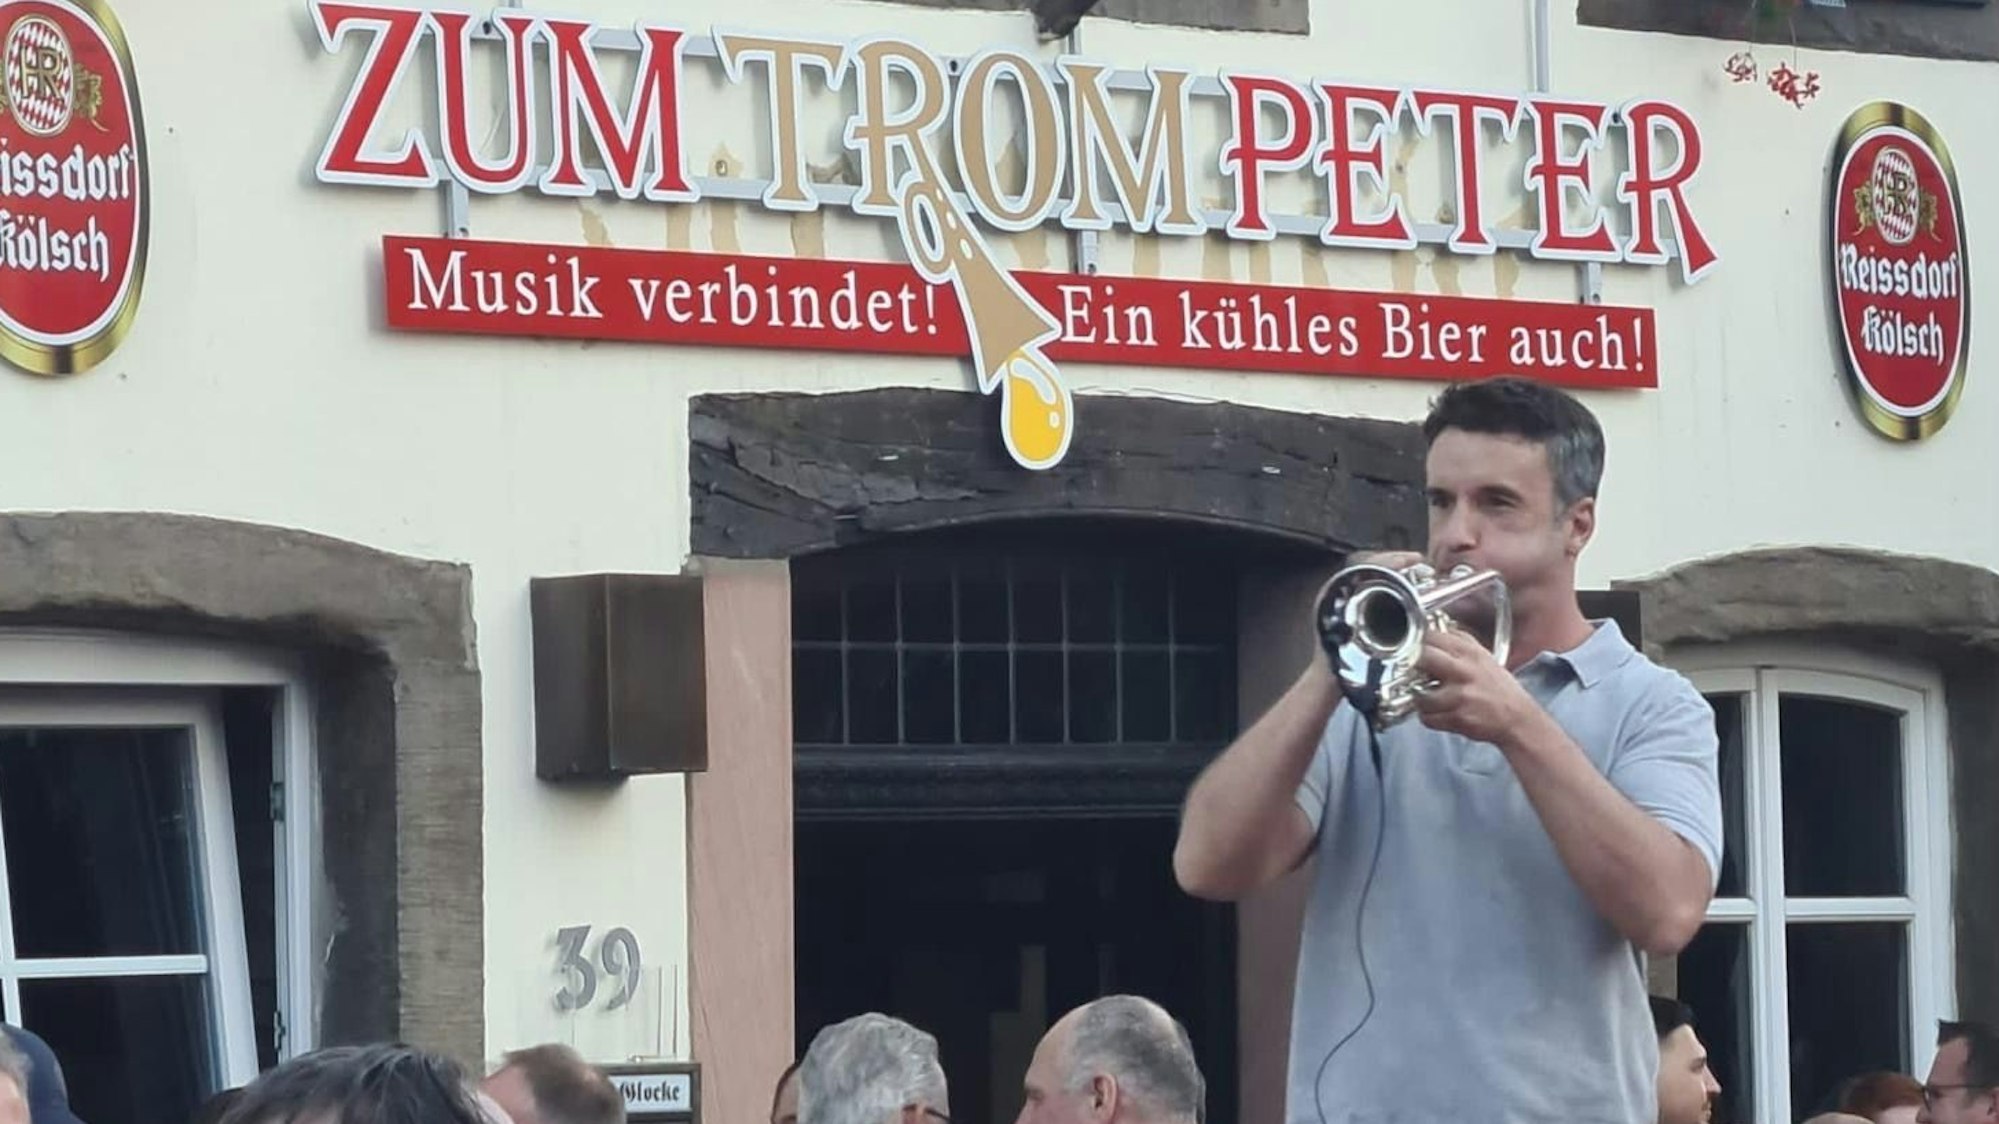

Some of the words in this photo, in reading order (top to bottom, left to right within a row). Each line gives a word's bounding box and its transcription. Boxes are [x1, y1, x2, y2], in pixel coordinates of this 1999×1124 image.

[0, 137, 135, 201] issdorf
[316, 3, 690, 193] ZUM
[719, 37, 1717, 272] TROMPETER
[1841, 243, 1957, 300] Reissdorf
[403, 247, 603, 319] Musik
[628, 263, 937, 335] verbindet!
[1057, 284, 1159, 347] Ein
[1178, 290, 1359, 357] kühles
[1379, 302, 1487, 363] Bier
[1509, 314, 1645, 372] auch!
[1861, 305, 1944, 366] Kölsch
[555, 925, 641, 1011] 39
